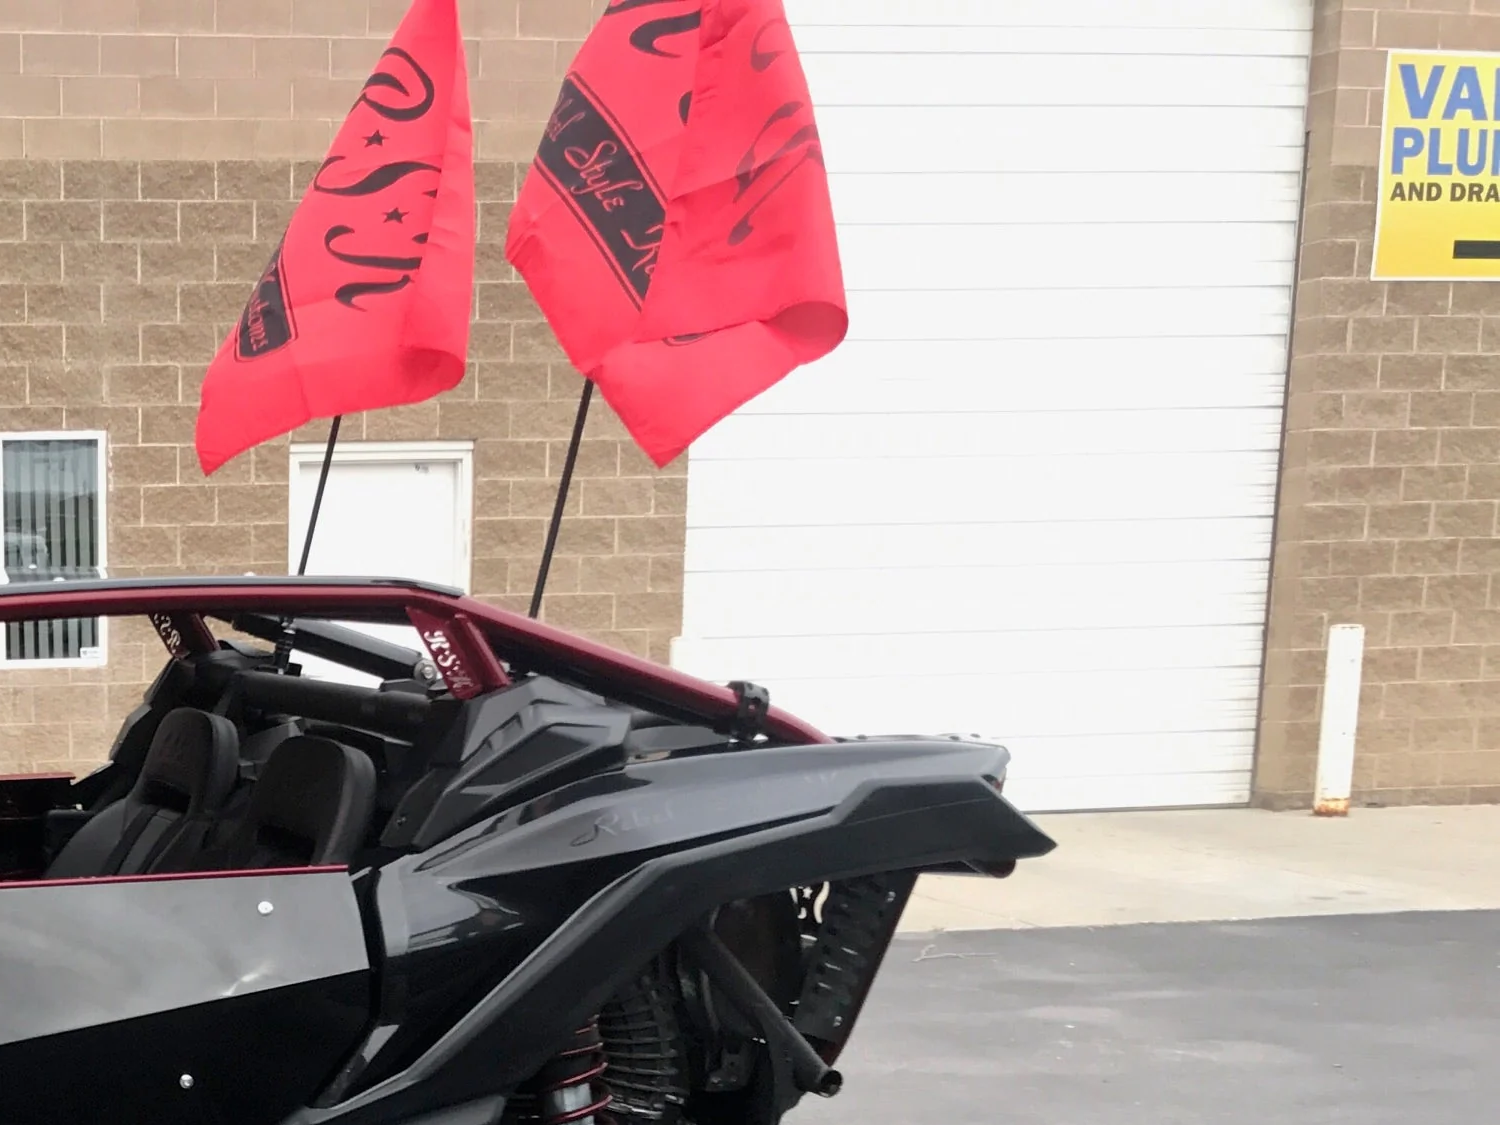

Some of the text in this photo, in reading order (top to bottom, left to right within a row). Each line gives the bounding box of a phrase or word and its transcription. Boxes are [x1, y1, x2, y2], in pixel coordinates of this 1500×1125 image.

[1398, 63, 1500, 121] VA
[564, 140, 644, 213] Style
[1390, 182, 1443, 202] AND
